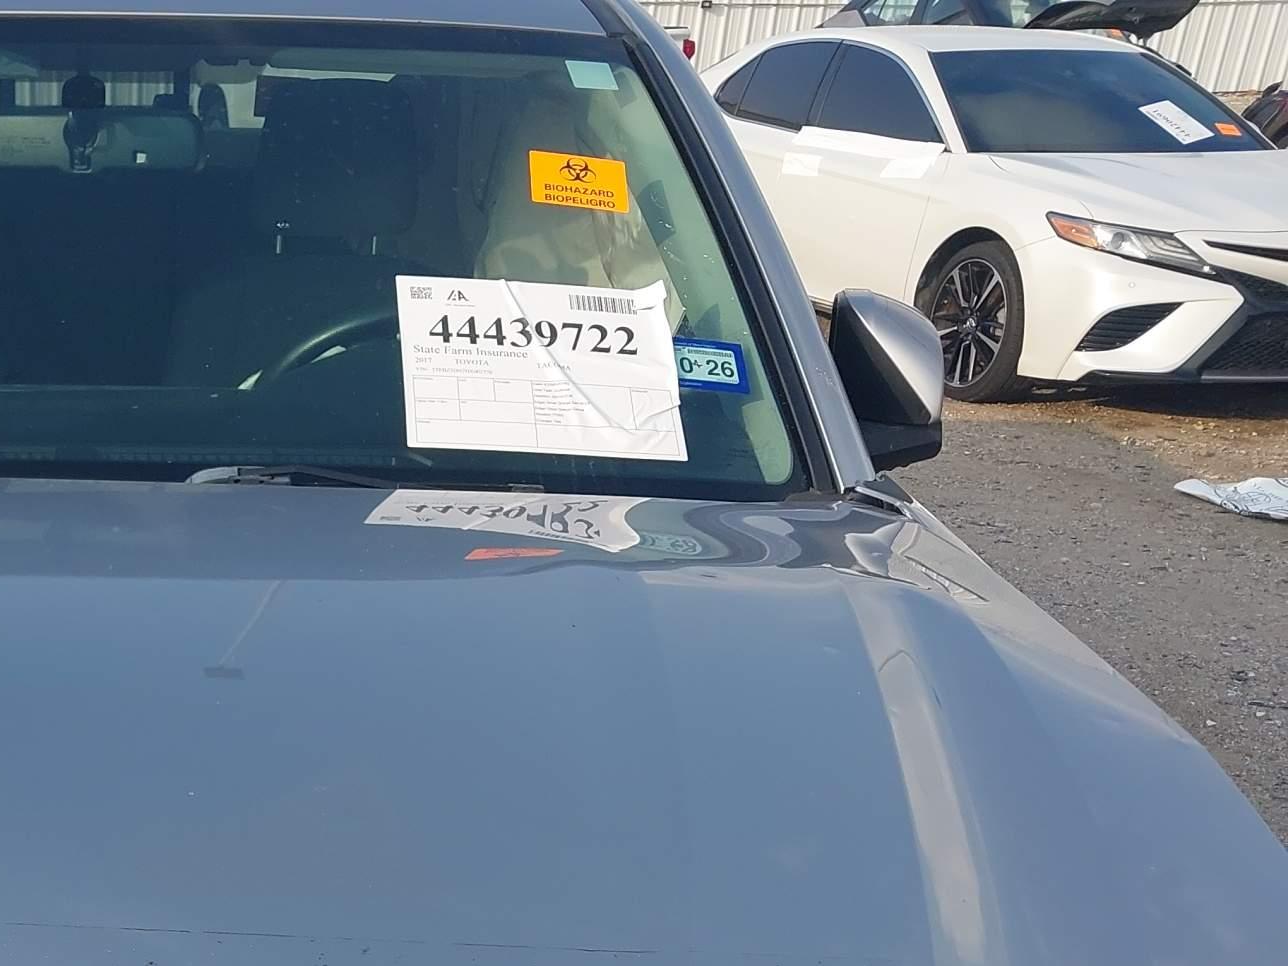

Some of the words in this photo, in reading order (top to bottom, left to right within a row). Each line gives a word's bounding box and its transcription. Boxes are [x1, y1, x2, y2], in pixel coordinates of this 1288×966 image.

[544, 183, 614, 197] BIOHAZARD
[544, 194, 615, 208] BIOPELIGRO
[429, 314, 638, 355] 44439722
[413, 344, 441, 354] State
[444, 346, 473, 355] Farm
[476, 347, 528, 358] Insurance
[455, 358, 489, 366] TOYOTA
